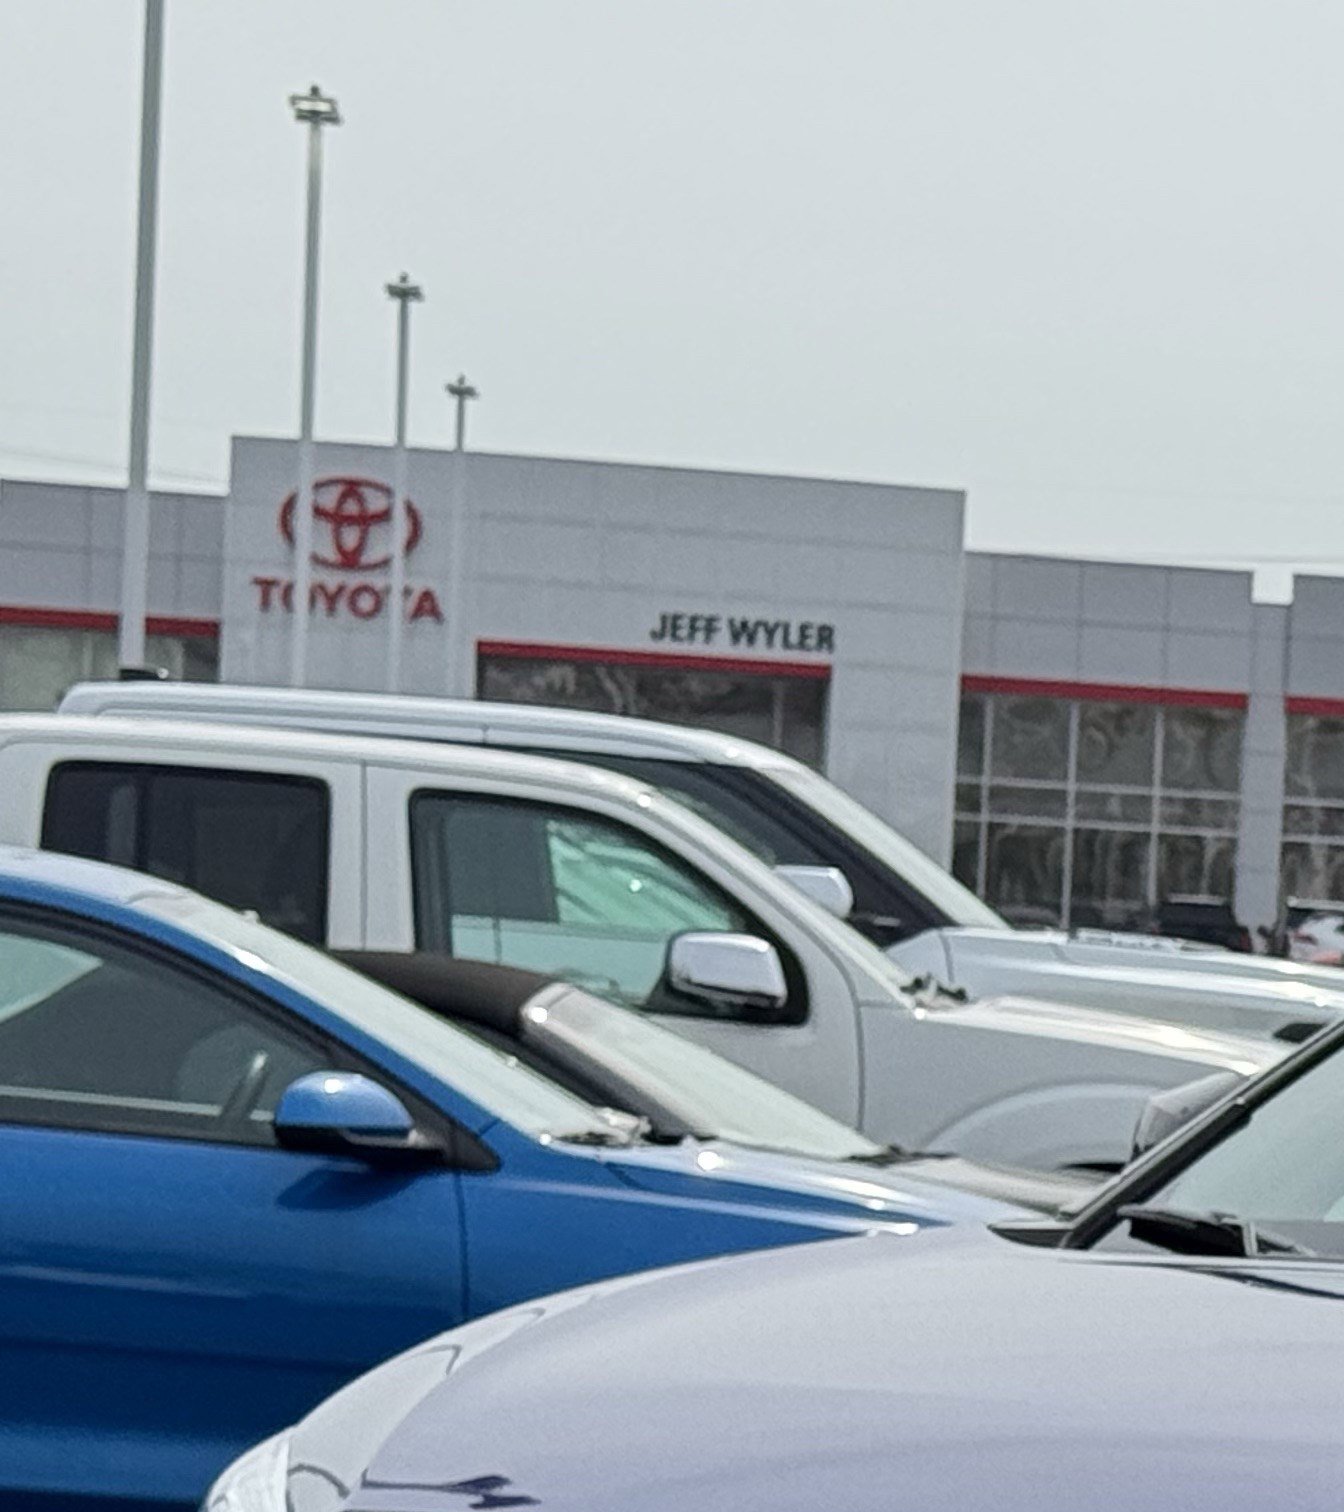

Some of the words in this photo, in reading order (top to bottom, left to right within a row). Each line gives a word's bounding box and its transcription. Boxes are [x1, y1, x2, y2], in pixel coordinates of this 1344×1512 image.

[252, 576, 445, 625] TOYOA
[650, 611, 722, 645] JEFF
[727, 616, 836, 654] WYLER
